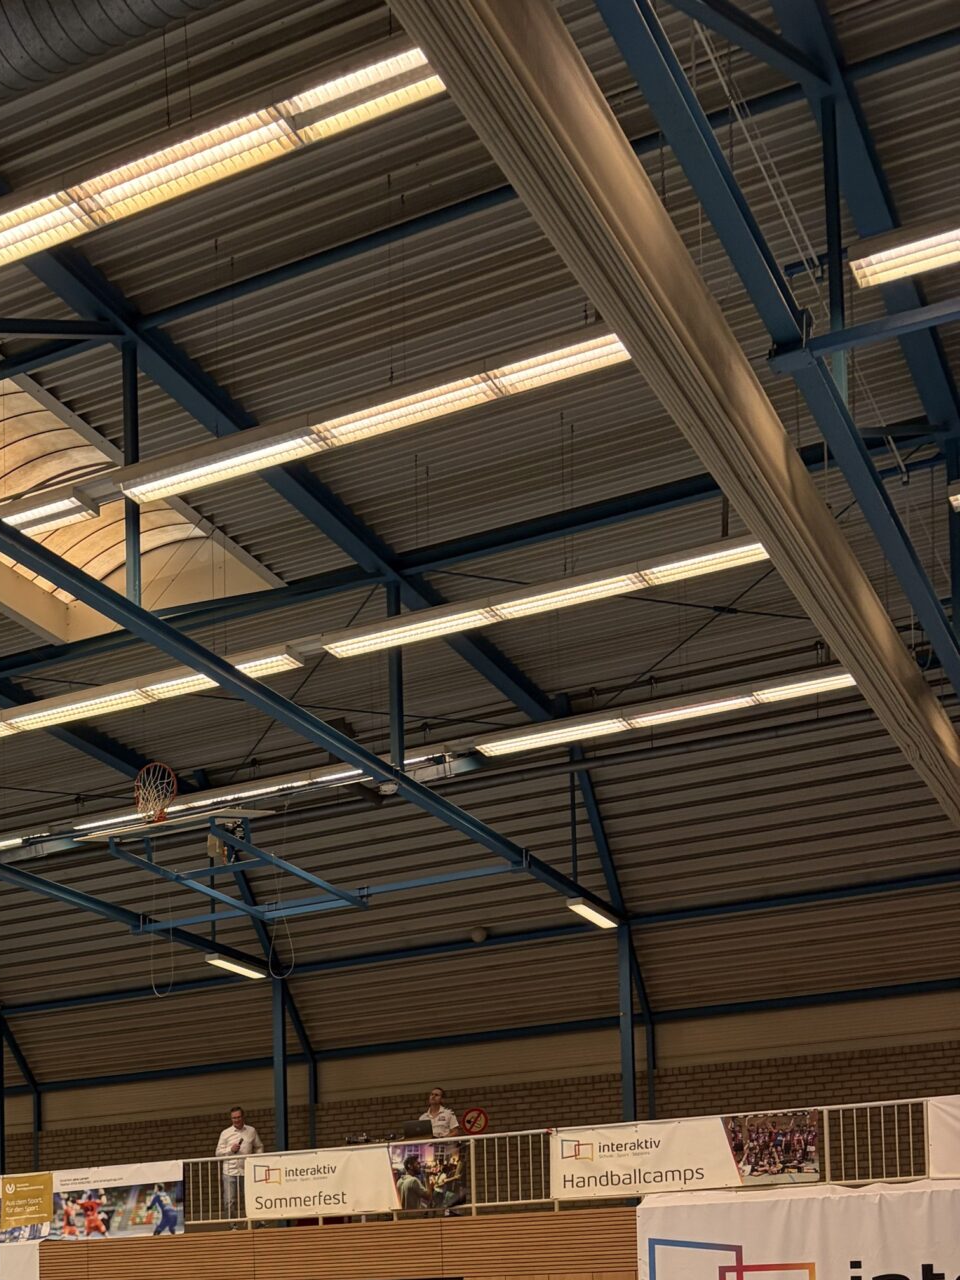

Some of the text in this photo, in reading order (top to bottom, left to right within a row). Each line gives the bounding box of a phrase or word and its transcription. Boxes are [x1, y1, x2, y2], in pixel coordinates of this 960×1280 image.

[598, 1137, 661, 1153] interaktiv
[284, 1164, 337, 1177] interaktiv
[563, 1167, 705, 1189] Handballcamps
[255, 1191, 347, 1210] Sommerfest
